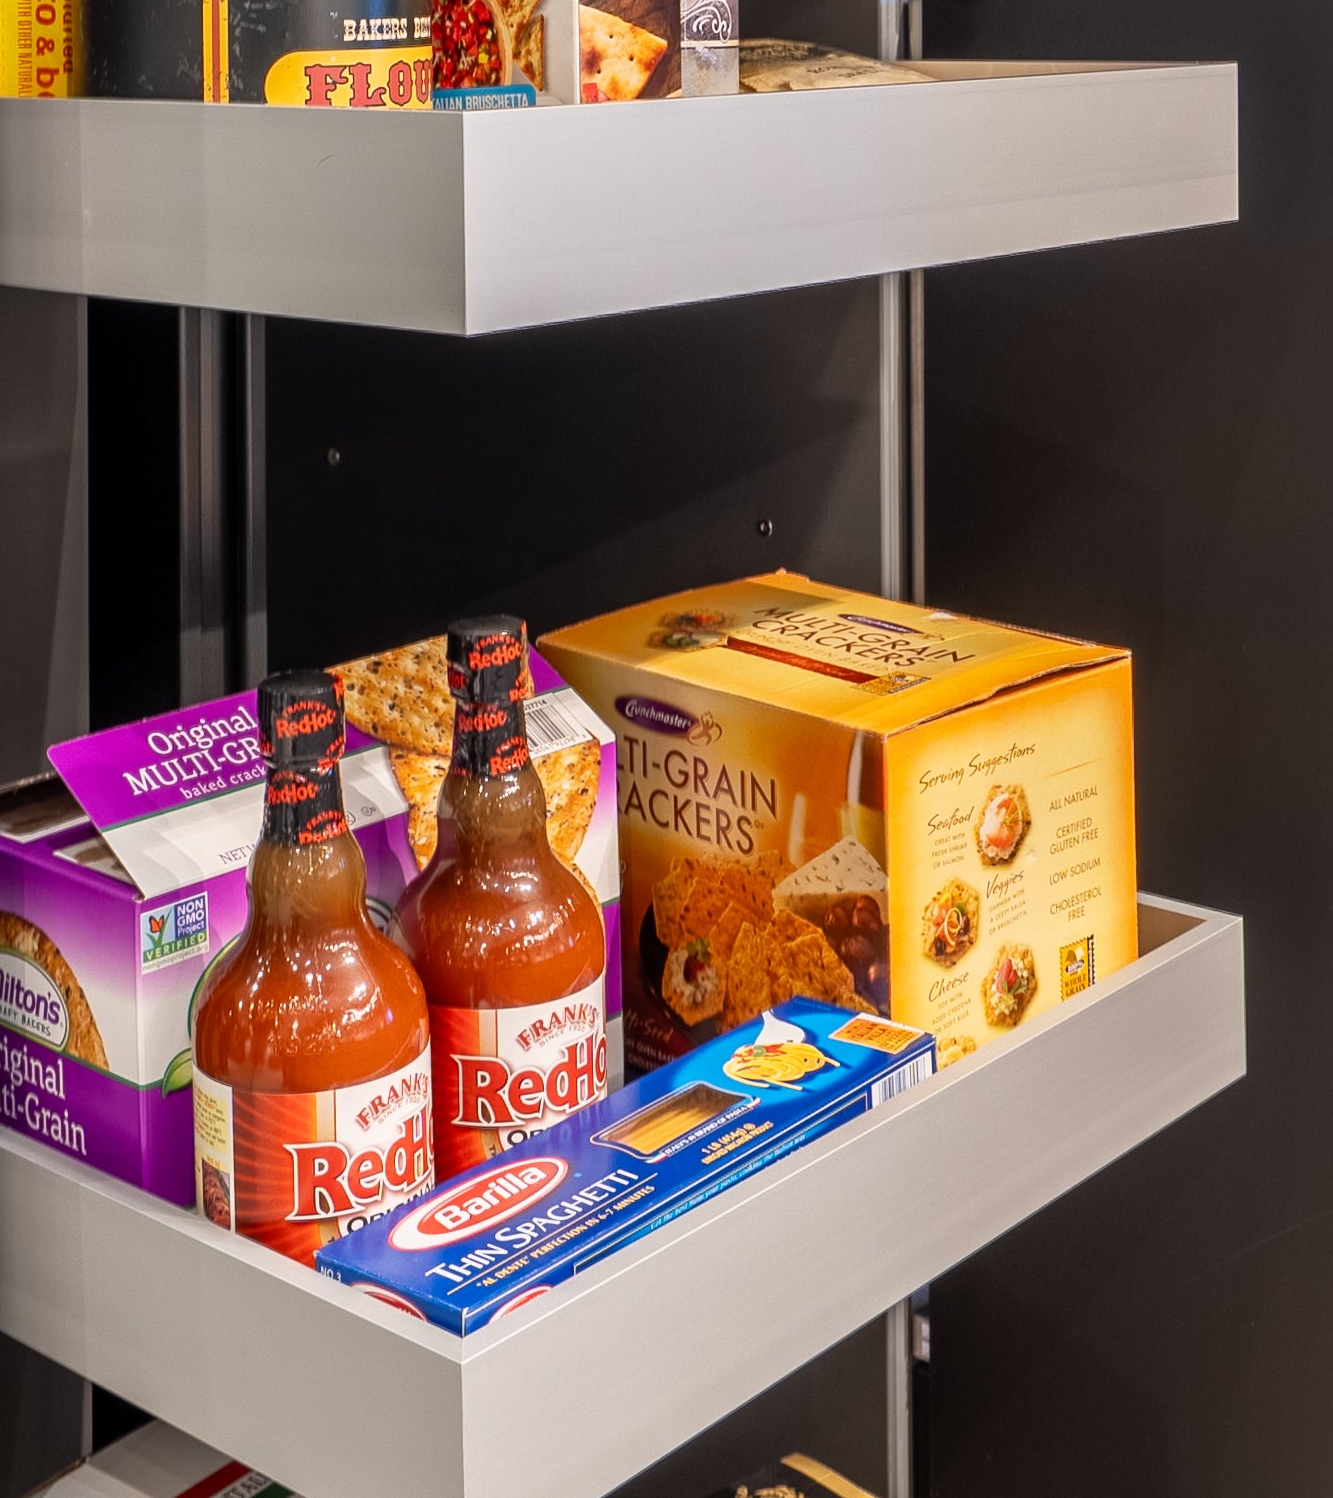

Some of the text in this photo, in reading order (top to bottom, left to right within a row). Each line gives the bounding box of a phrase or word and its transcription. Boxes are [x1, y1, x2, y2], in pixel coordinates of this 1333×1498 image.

[343, 18, 407, 42] BAKERS
[36, 35, 55, 57] &
[304, 59, 432, 107] FLOU
[752, 619, 924, 667] CRACKERS
[754, 606, 975, 663] MULTI-GRAIN
[276, 710, 336, 739] RedHot
[626, 699, 688, 729] Crunchmaster
[147, 705, 258, 755] Original
[123, 736, 261, 796] MULTI-GR
[617, 735, 777, 819] TI-GRAIN
[920, 743, 1036, 794] Serving Suggestions
[180, 778, 226, 800] baked
[230, 764, 267, 785] crack
[1049, 786, 1098, 812] ALL NATURAL
[618, 780, 754, 855] ACKERS
[928, 806, 975, 836] Seafood
[1056, 817, 1092, 839] CERTIFIED
[1050, 828, 1099, 855] GLUTEN FREE
[987, 869, 1024, 899] Veggies
[1049, 858, 1101, 886] LOW SODIUM
[177, 897, 204, 915] NON
[1050, 886, 1102, 915] CHOLESTEROL
[1068, 906, 1085, 922] FREE
[177, 910, 205, 925] GMO
[178, 922, 205, 938] Project
[146, 932, 206, 960] VERIFIED
[929, 971, 969, 1003] Cheese
[21, 1014, 51, 1037] BAKERS
[517, 1003, 598, 1050] FRANK'S
[450, 1032, 607, 1127] RedHo
[356, 1072, 429, 1130] FRANK'S
[283, 1102, 434, 1221] RedH
[434, 1164, 548, 1230] Barilla
[425, 1243, 508, 1284] THIN
[494, 1169, 638, 1249] SPAGHETTI
[530, 1226, 586, 1260] PERFECTION
[586, 1218, 598, 1229] IN
[598, 1206, 613, 1222] 6-7
[613, 1185, 656, 1212] MINUTES
